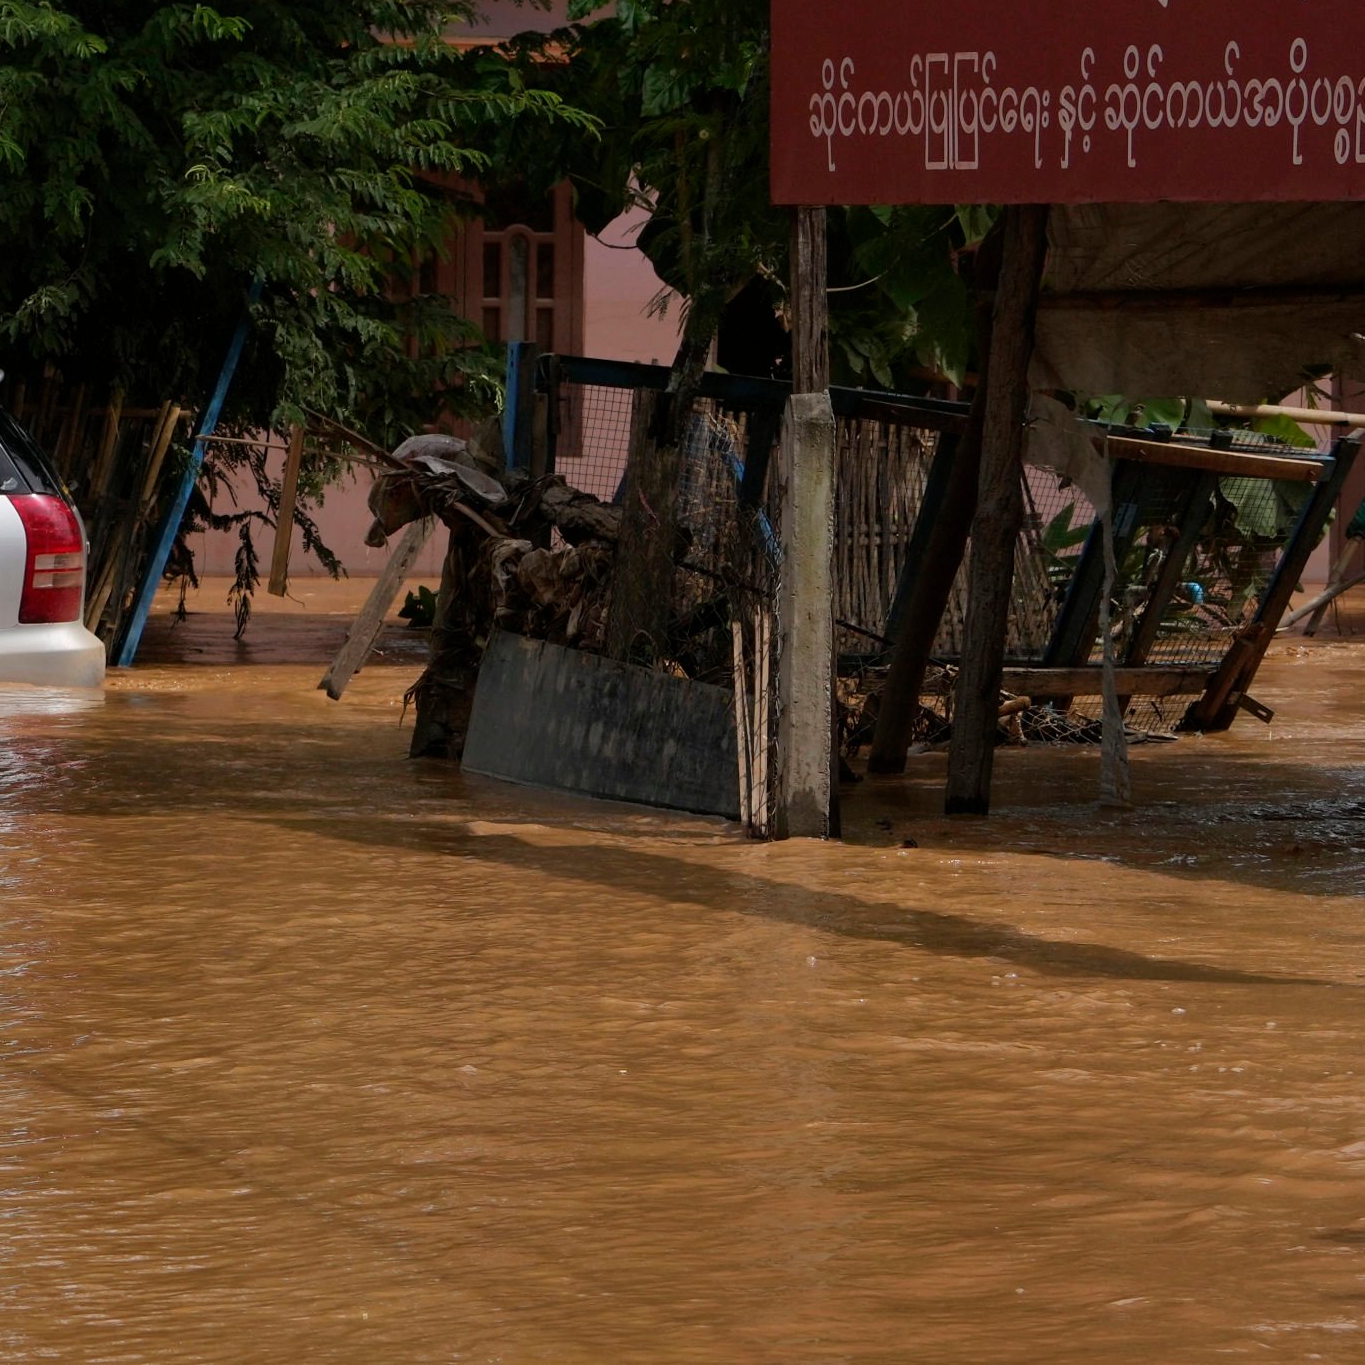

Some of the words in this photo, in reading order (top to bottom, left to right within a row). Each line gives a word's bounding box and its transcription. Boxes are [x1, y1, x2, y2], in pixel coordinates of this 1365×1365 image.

[1104, 37, 1365, 169] ဆိုင်ကယ်အပိုပစ္စ
